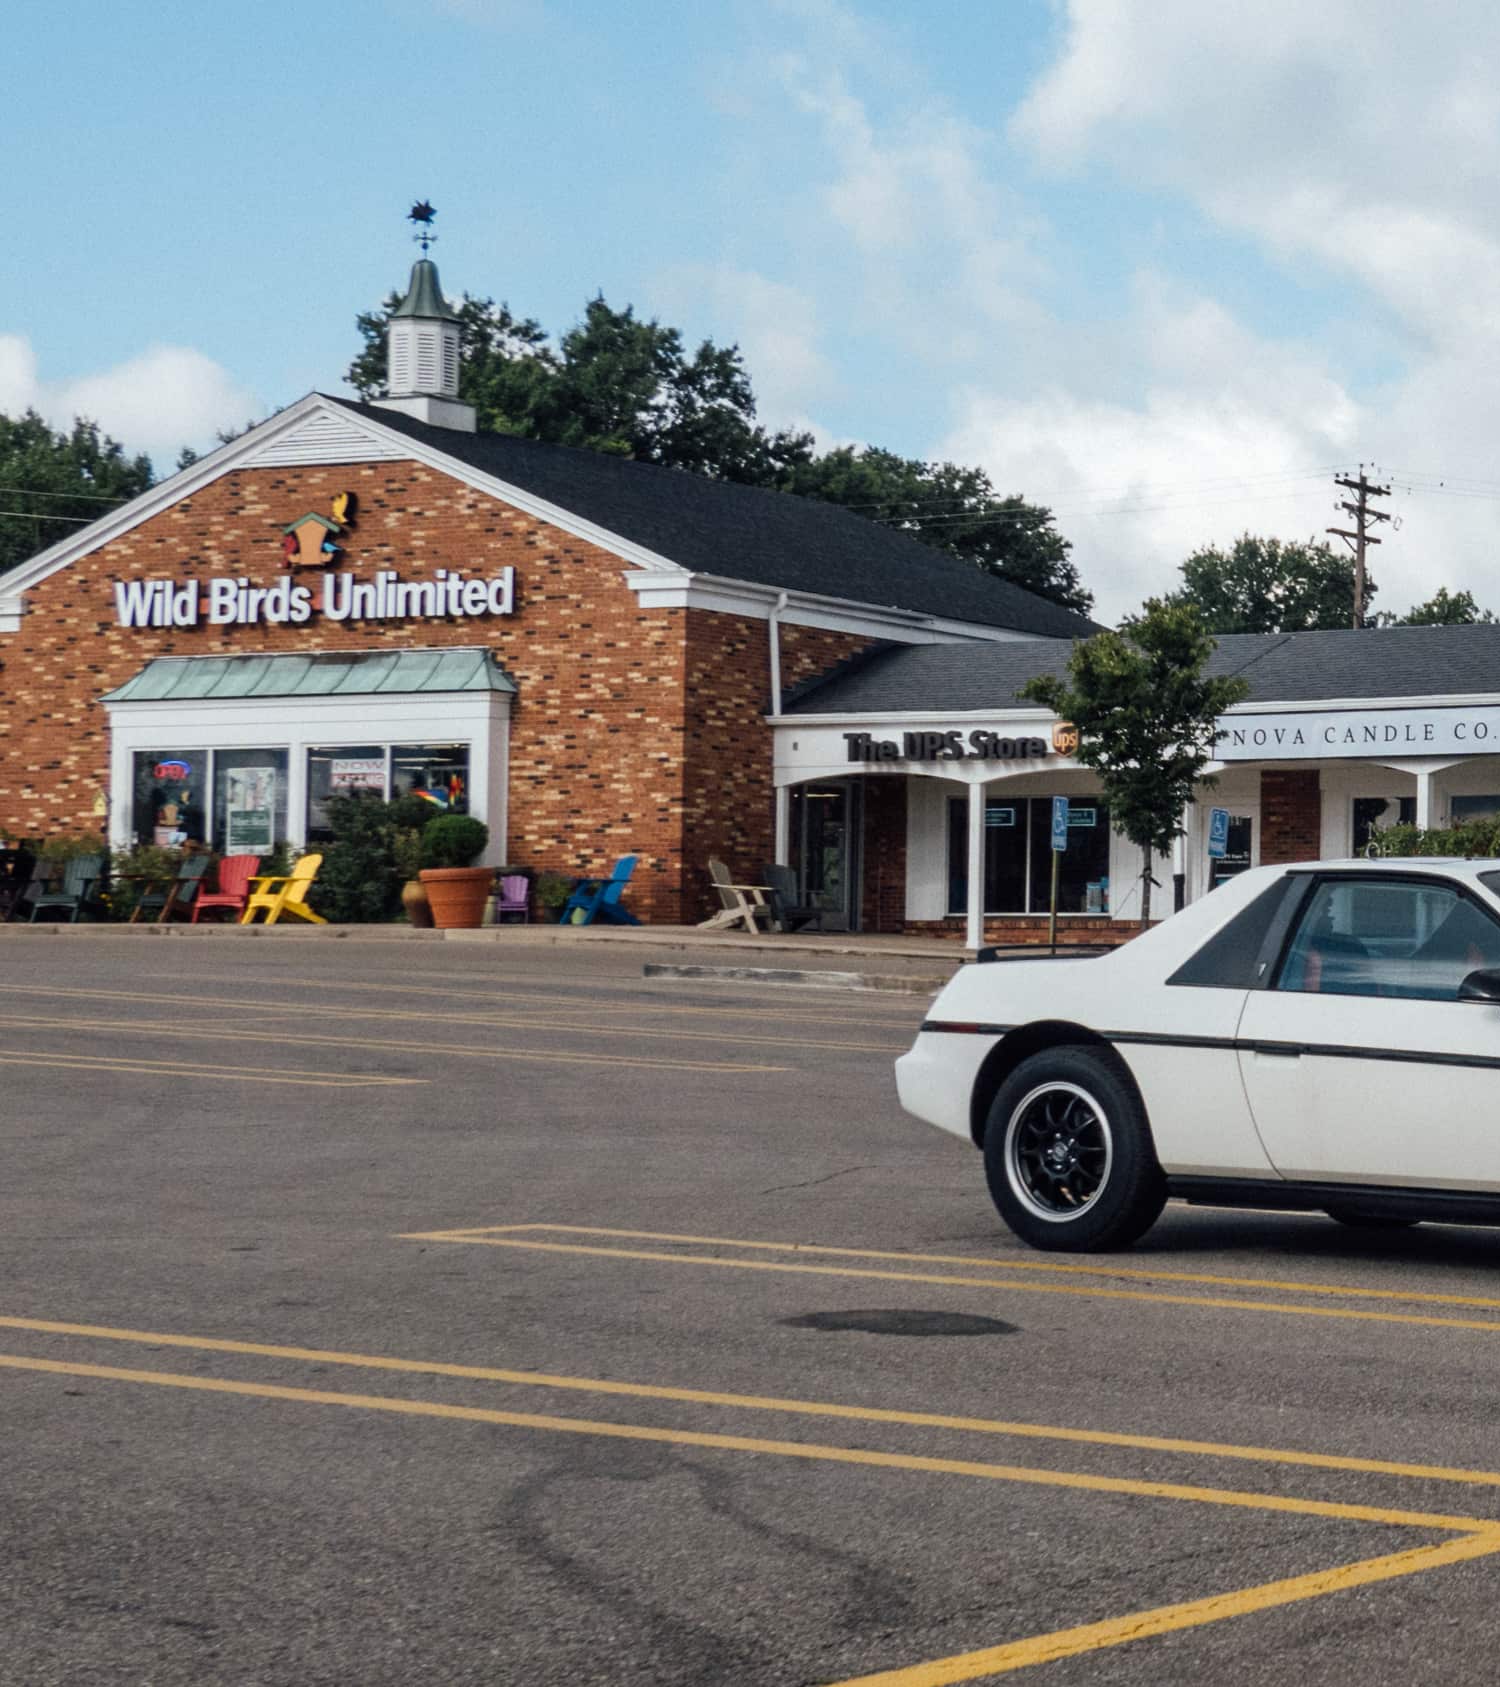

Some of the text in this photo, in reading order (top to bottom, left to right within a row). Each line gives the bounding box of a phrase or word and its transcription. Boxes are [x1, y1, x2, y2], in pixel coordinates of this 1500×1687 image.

[114, 566, 514, 627] Wild Birds Unlimited
[843, 730, 1047, 762] The UPS Store
[1055, 732, 1077, 751] ups
[1233, 722, 1497, 746] NOVA CANDLE CO.
